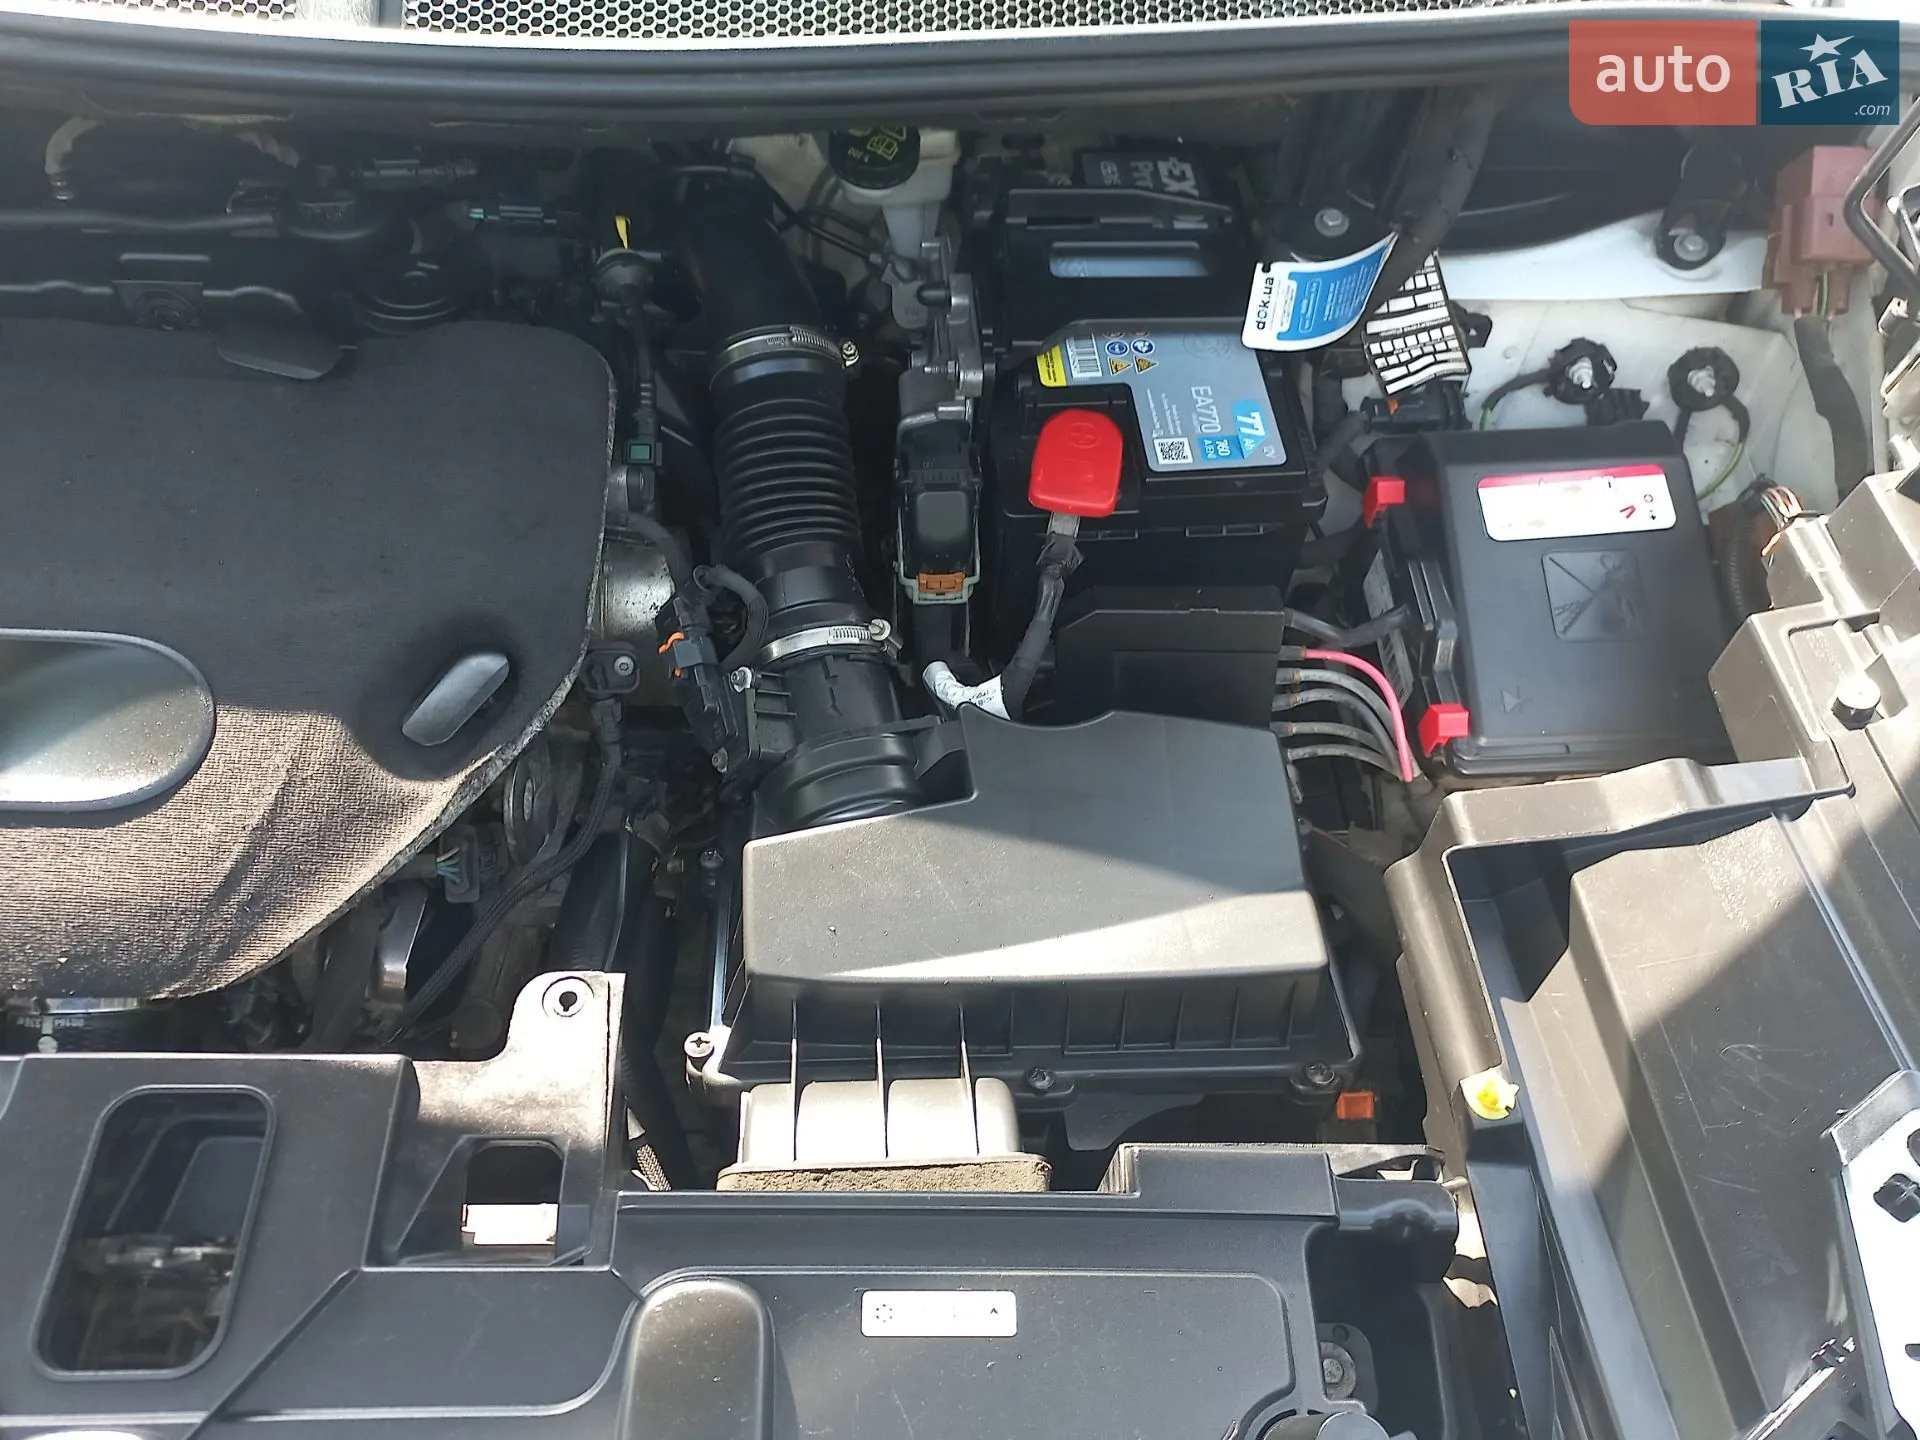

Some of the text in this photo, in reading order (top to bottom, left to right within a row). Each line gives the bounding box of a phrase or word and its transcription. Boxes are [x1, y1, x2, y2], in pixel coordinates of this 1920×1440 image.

[1256, 276, 1275, 330] dok.ua
[1191, 385, 1221, 433] EA770
[1236, 411, 1265, 436] 77
[1215, 439, 1230, 456] 760
